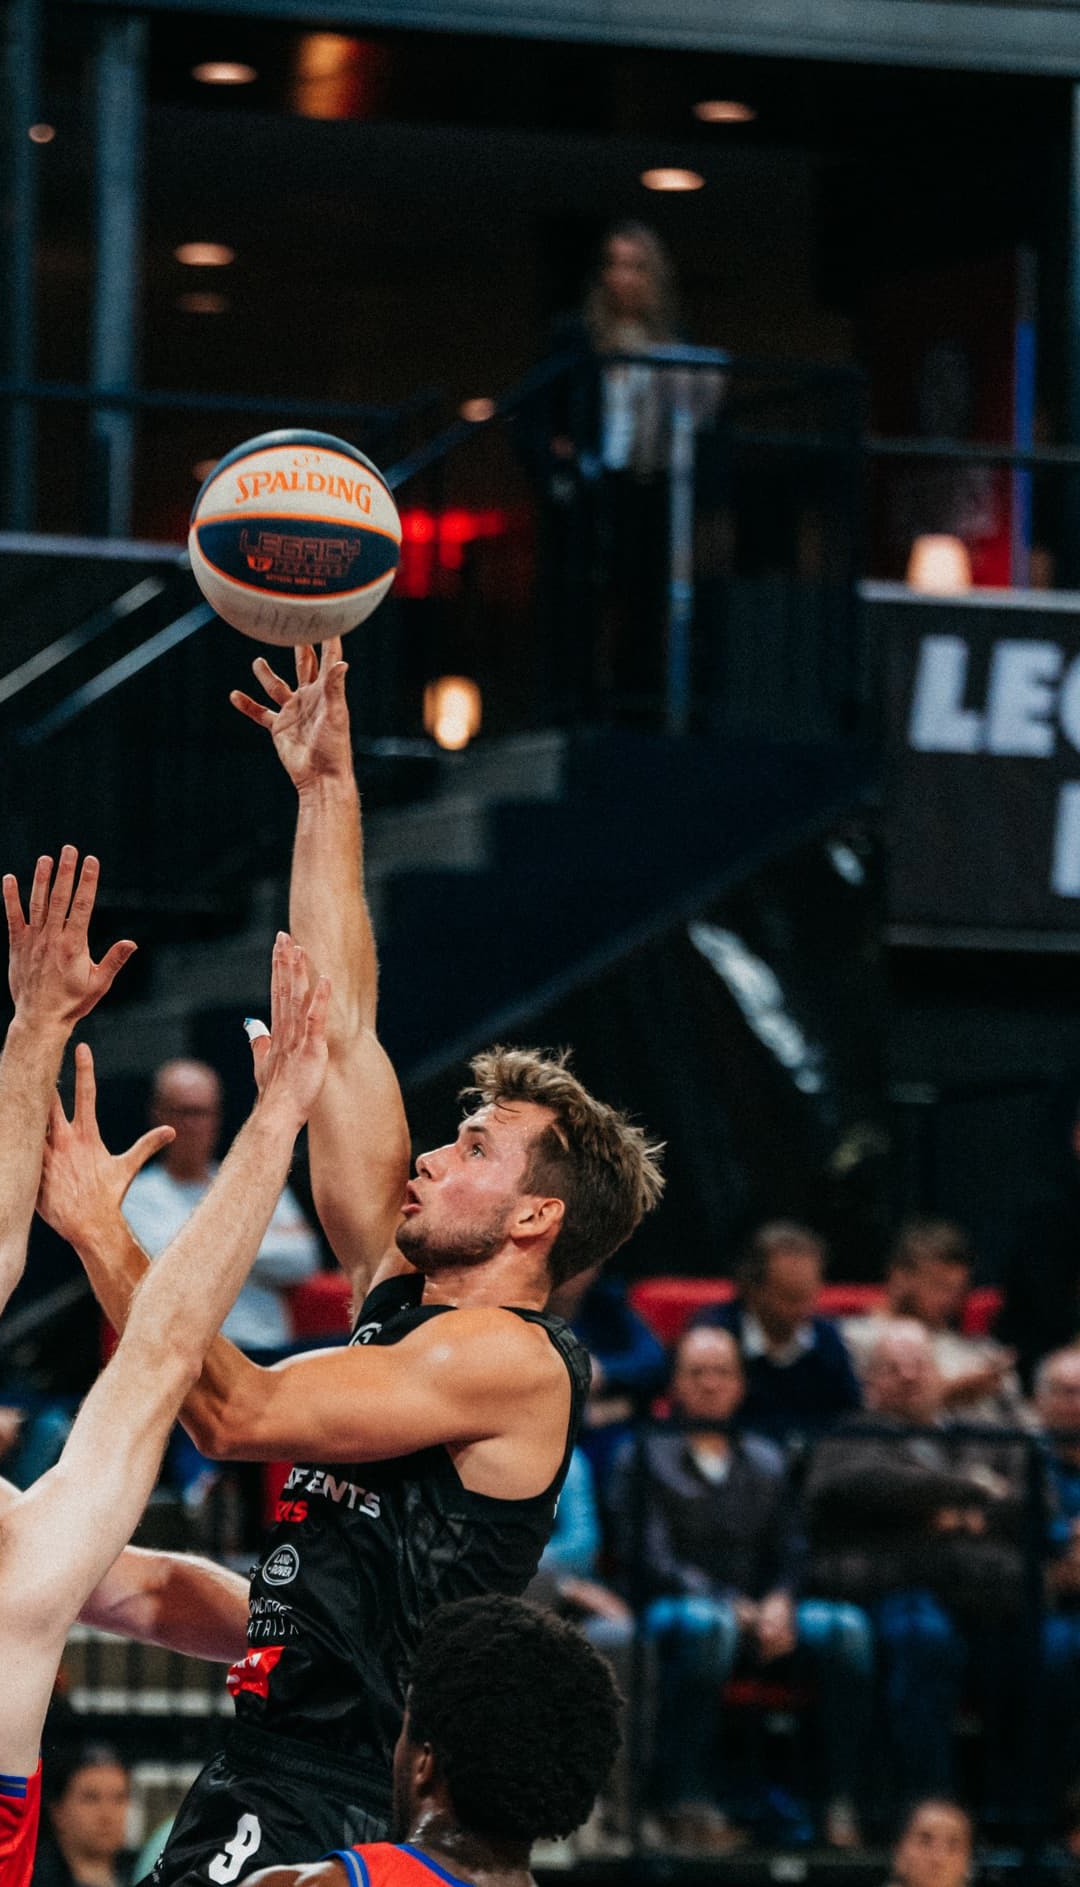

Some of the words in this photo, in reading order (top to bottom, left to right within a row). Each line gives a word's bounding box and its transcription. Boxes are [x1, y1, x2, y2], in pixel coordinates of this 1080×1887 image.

[235, 470, 373, 515] SPALDING
[909, 633, 1080, 758] LE
[209, 1812, 262, 1885] 9
